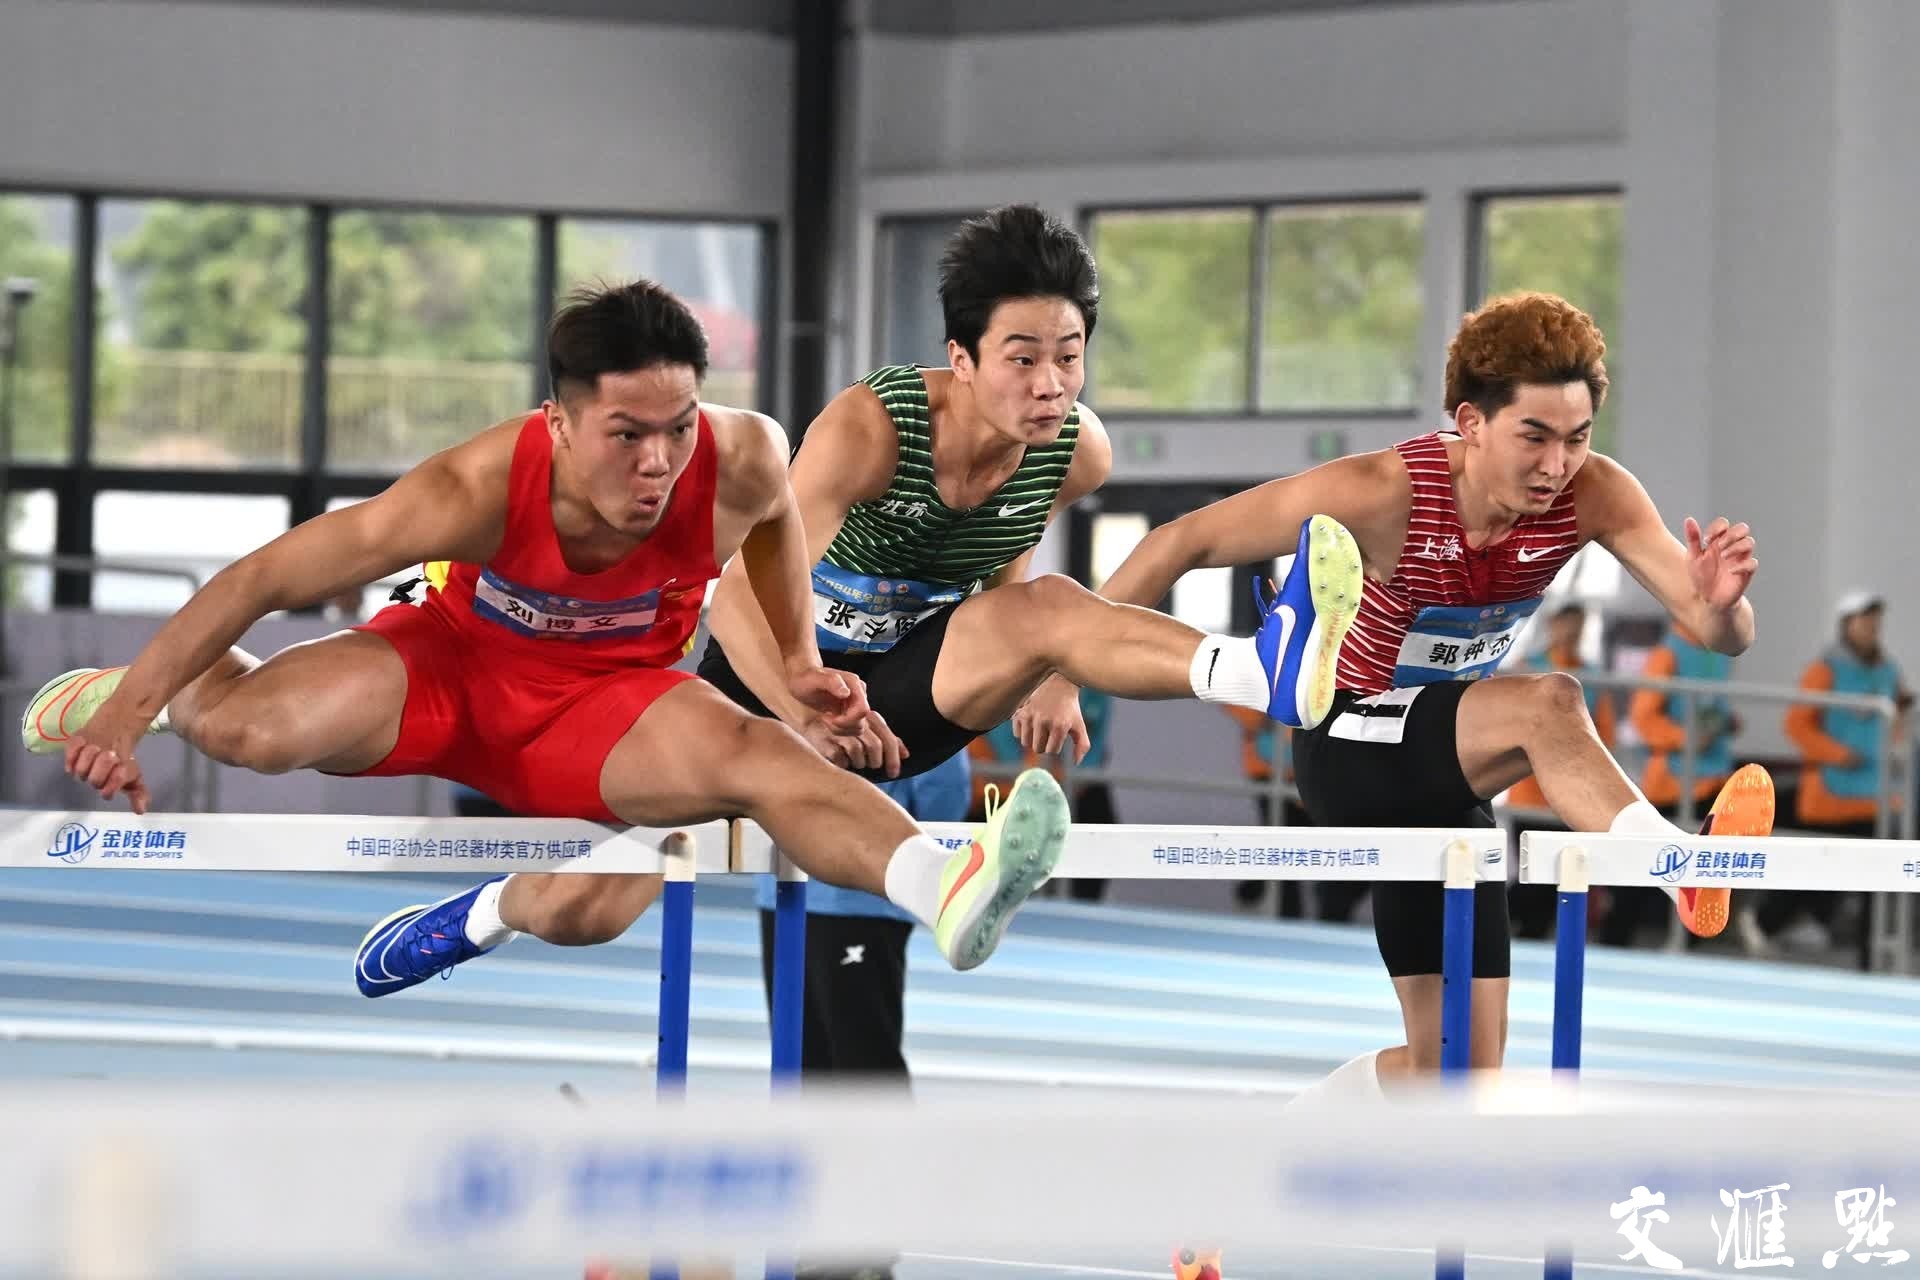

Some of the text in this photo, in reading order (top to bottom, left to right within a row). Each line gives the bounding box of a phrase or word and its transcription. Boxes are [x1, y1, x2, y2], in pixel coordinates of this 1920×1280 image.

[880, 499, 929, 518] 江苏
[1415, 536, 1464, 561] 上海
[504, 598, 618, 631] 刘博文
[1429, 634, 1511, 665] 郭钟杰
[102, 829, 187, 849] 金陵体育
[346, 836, 592, 860] 中国田径协会田径器材类官方供应商
[101, 850, 184, 860] JINLING SPORTS
[1152, 845, 1381, 867] 中国田径协会田径器材类官方供应商
[1696, 851, 1767, 870] 金陵体育
[1696, 870, 1765, 879] JINLING SPORTS
